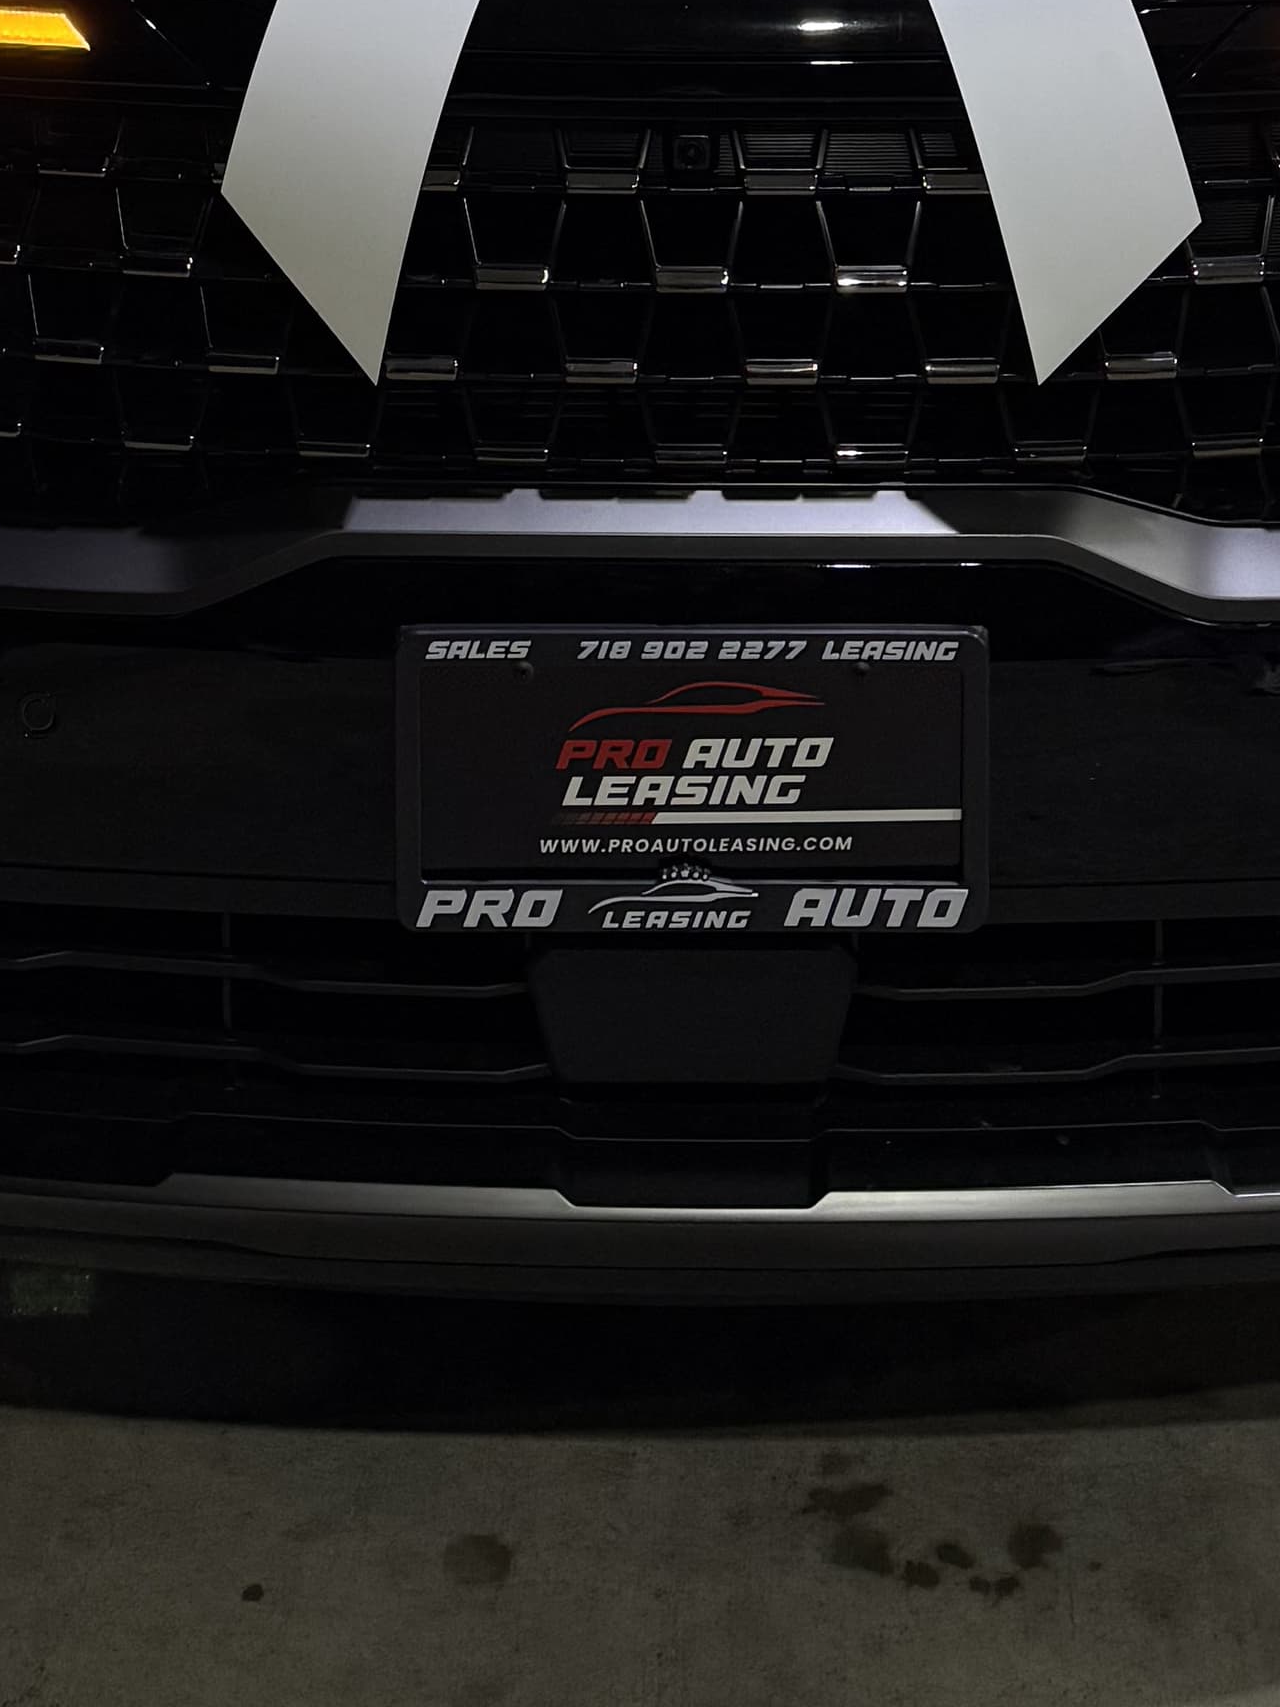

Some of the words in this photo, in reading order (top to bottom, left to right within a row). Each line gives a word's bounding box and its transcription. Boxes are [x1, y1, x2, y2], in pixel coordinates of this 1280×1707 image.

[425, 640, 532, 660] SALES
[576, 640, 632, 660] 718
[640, 640, 707, 660] 902
[717, 640, 808, 660] 2277
[822, 640, 960, 661] LEASING
[554, 738, 673, 770] PRO
[681, 737, 835, 769] AUTO
[561, 774, 807, 807] LEASING
[539, 835, 854, 854] WWW.PROAUTOLEASING.COM
[415, 889, 564, 929] PRO
[601, 910, 752, 930] LEASING
[783, 888, 970, 929] AUTO
